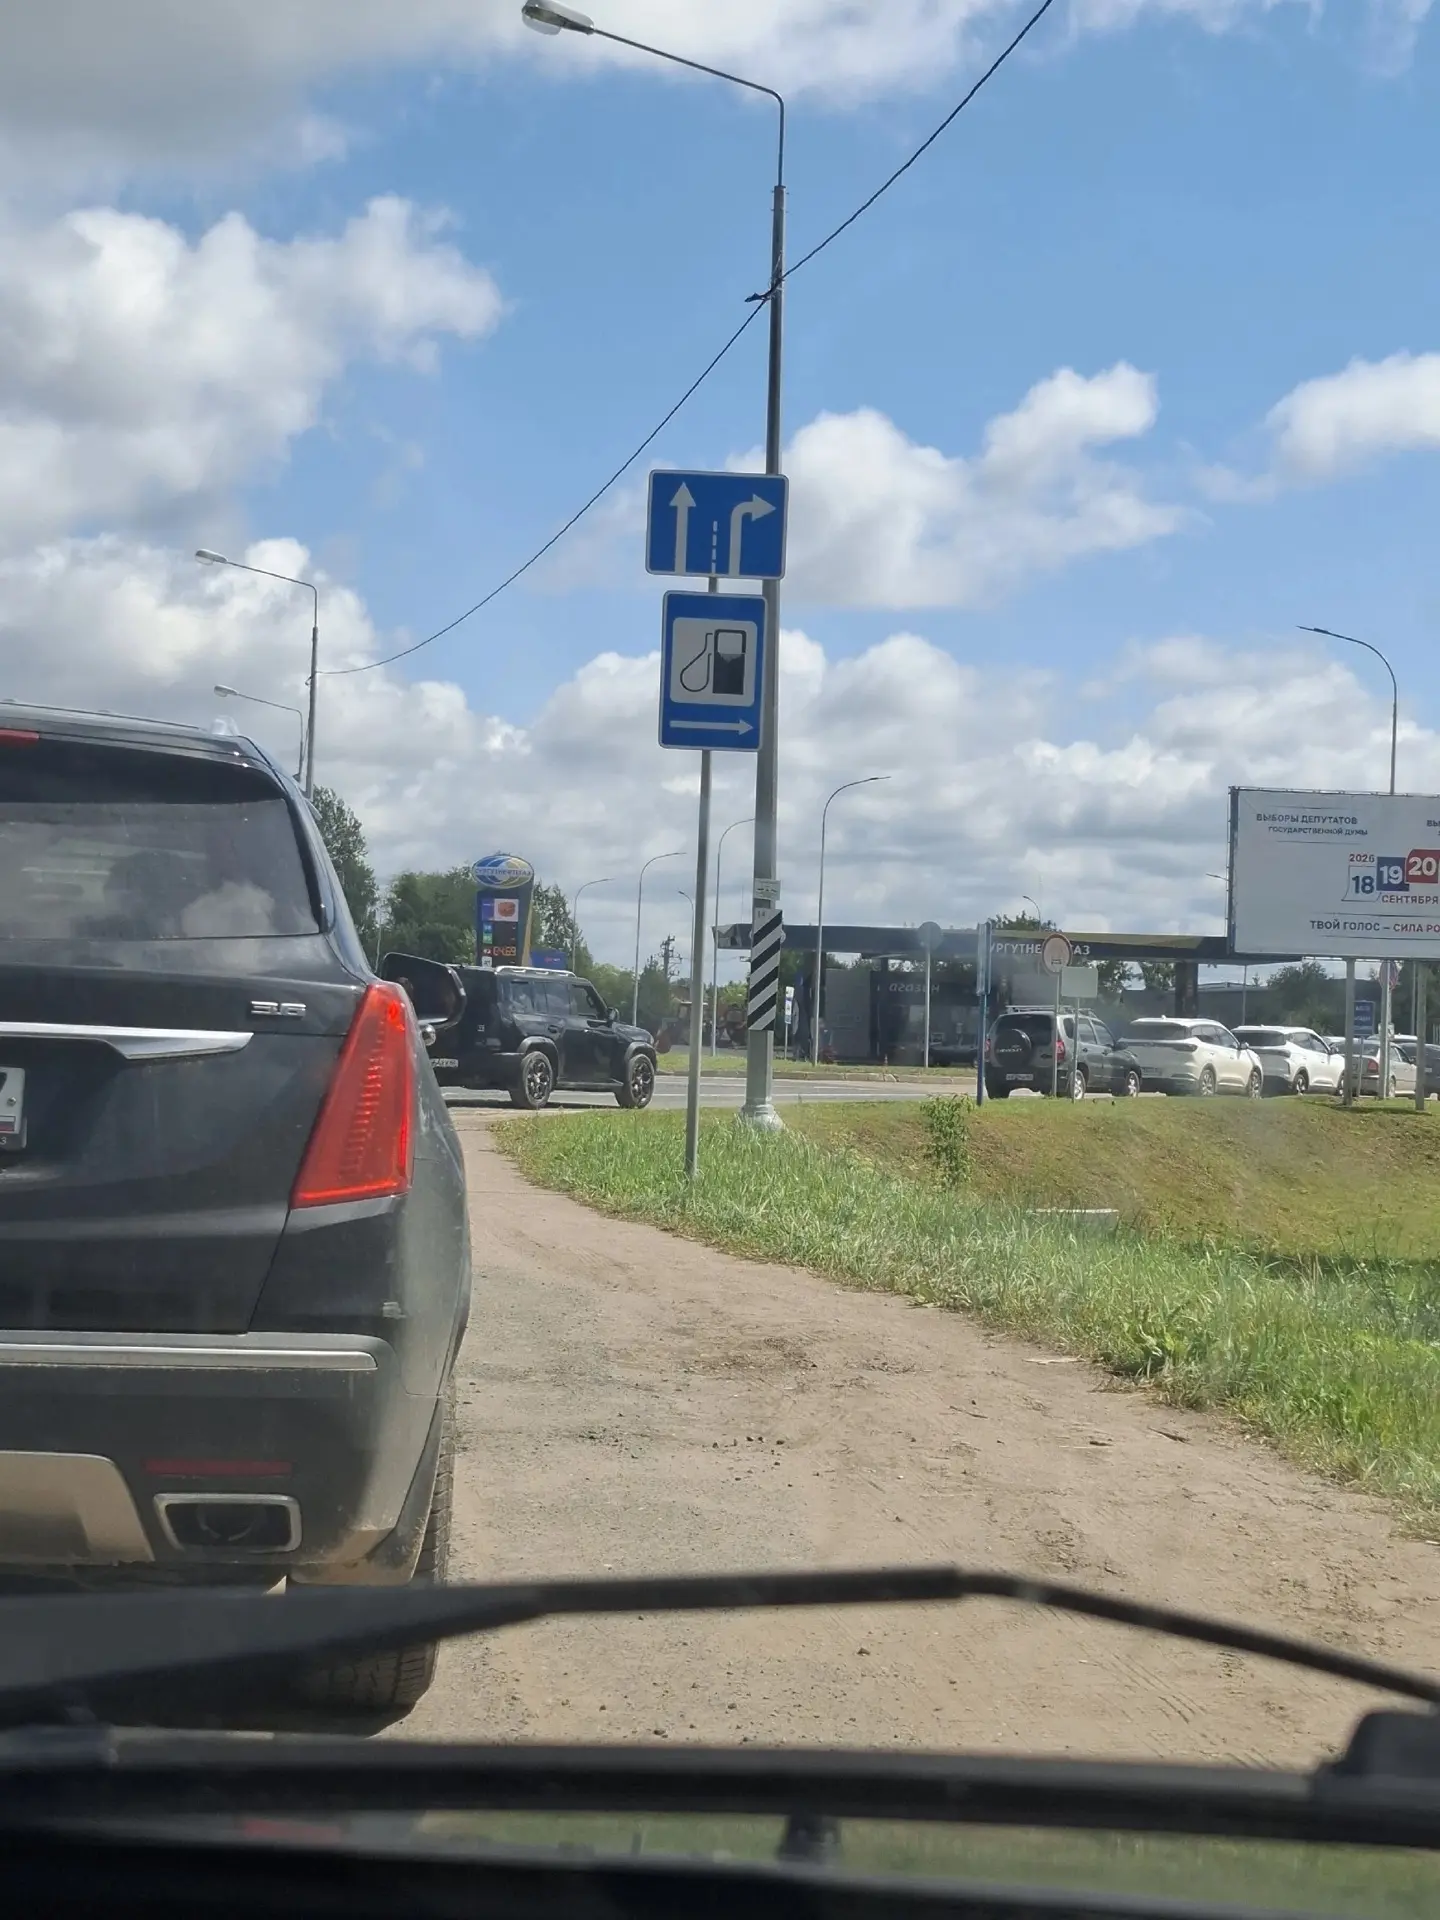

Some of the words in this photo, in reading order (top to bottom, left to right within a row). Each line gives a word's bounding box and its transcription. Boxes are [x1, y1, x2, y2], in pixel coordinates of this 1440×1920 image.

[1256, 813, 1299, 823] ВЫБОРЫ
[1300, 814, 1358, 825] ДЕПУТАТОВ
[1268, 826, 1343, 835] ГОСУДАРСТВЕННОЙ
[1344, 828, 1368, 836] ДУМЫ
[1349, 853, 1375, 863] 2026
[1351, 875, 1374, 895] 18
[1379, 865, 1403, 885] 19
[1407, 856, 1437, 876] 20
[1381, 894, 1439, 905] СЕНТЯБРЯ
[1310, 918, 1340, 930] ТВОЙ
[1343, 921, 1380, 931] ГОЛОС
[1393, 923, 1423, 932] СИЛА
